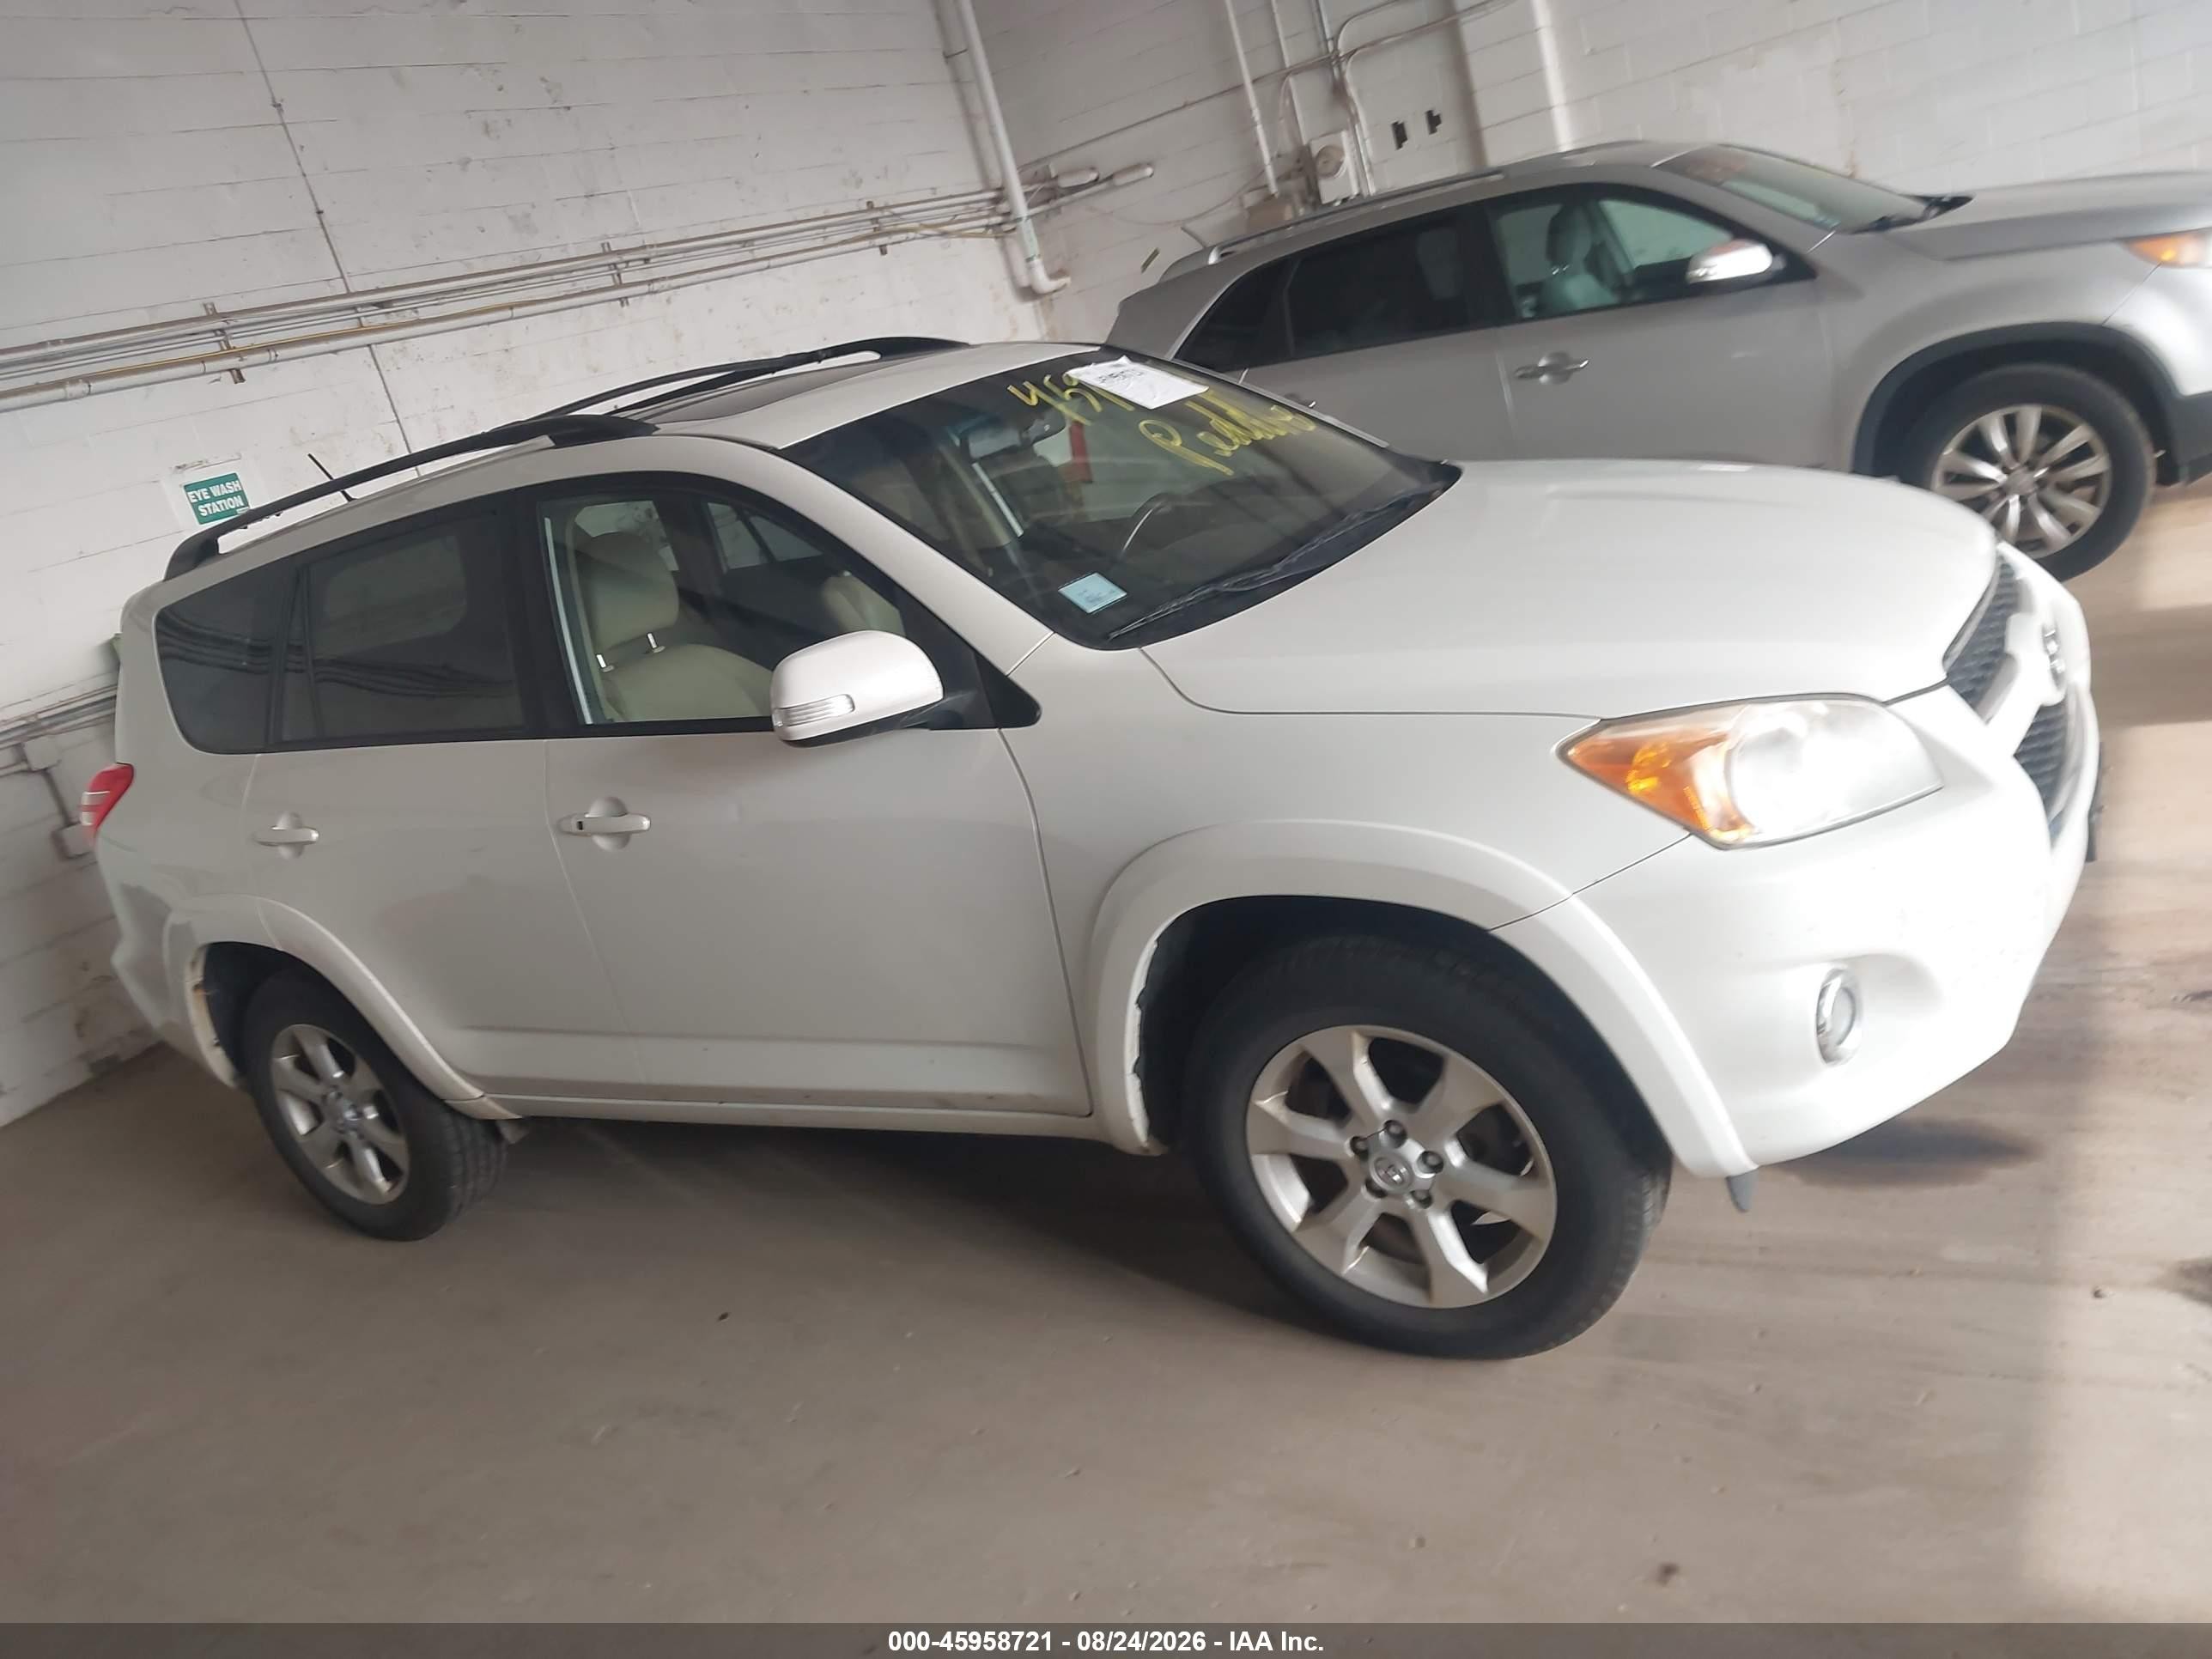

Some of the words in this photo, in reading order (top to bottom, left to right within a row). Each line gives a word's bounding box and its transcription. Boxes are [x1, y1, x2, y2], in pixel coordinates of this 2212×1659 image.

[188, 488, 210, 502] EYE
[209, 480, 241, 496] WASH
[198, 495, 244, 516] STATION
